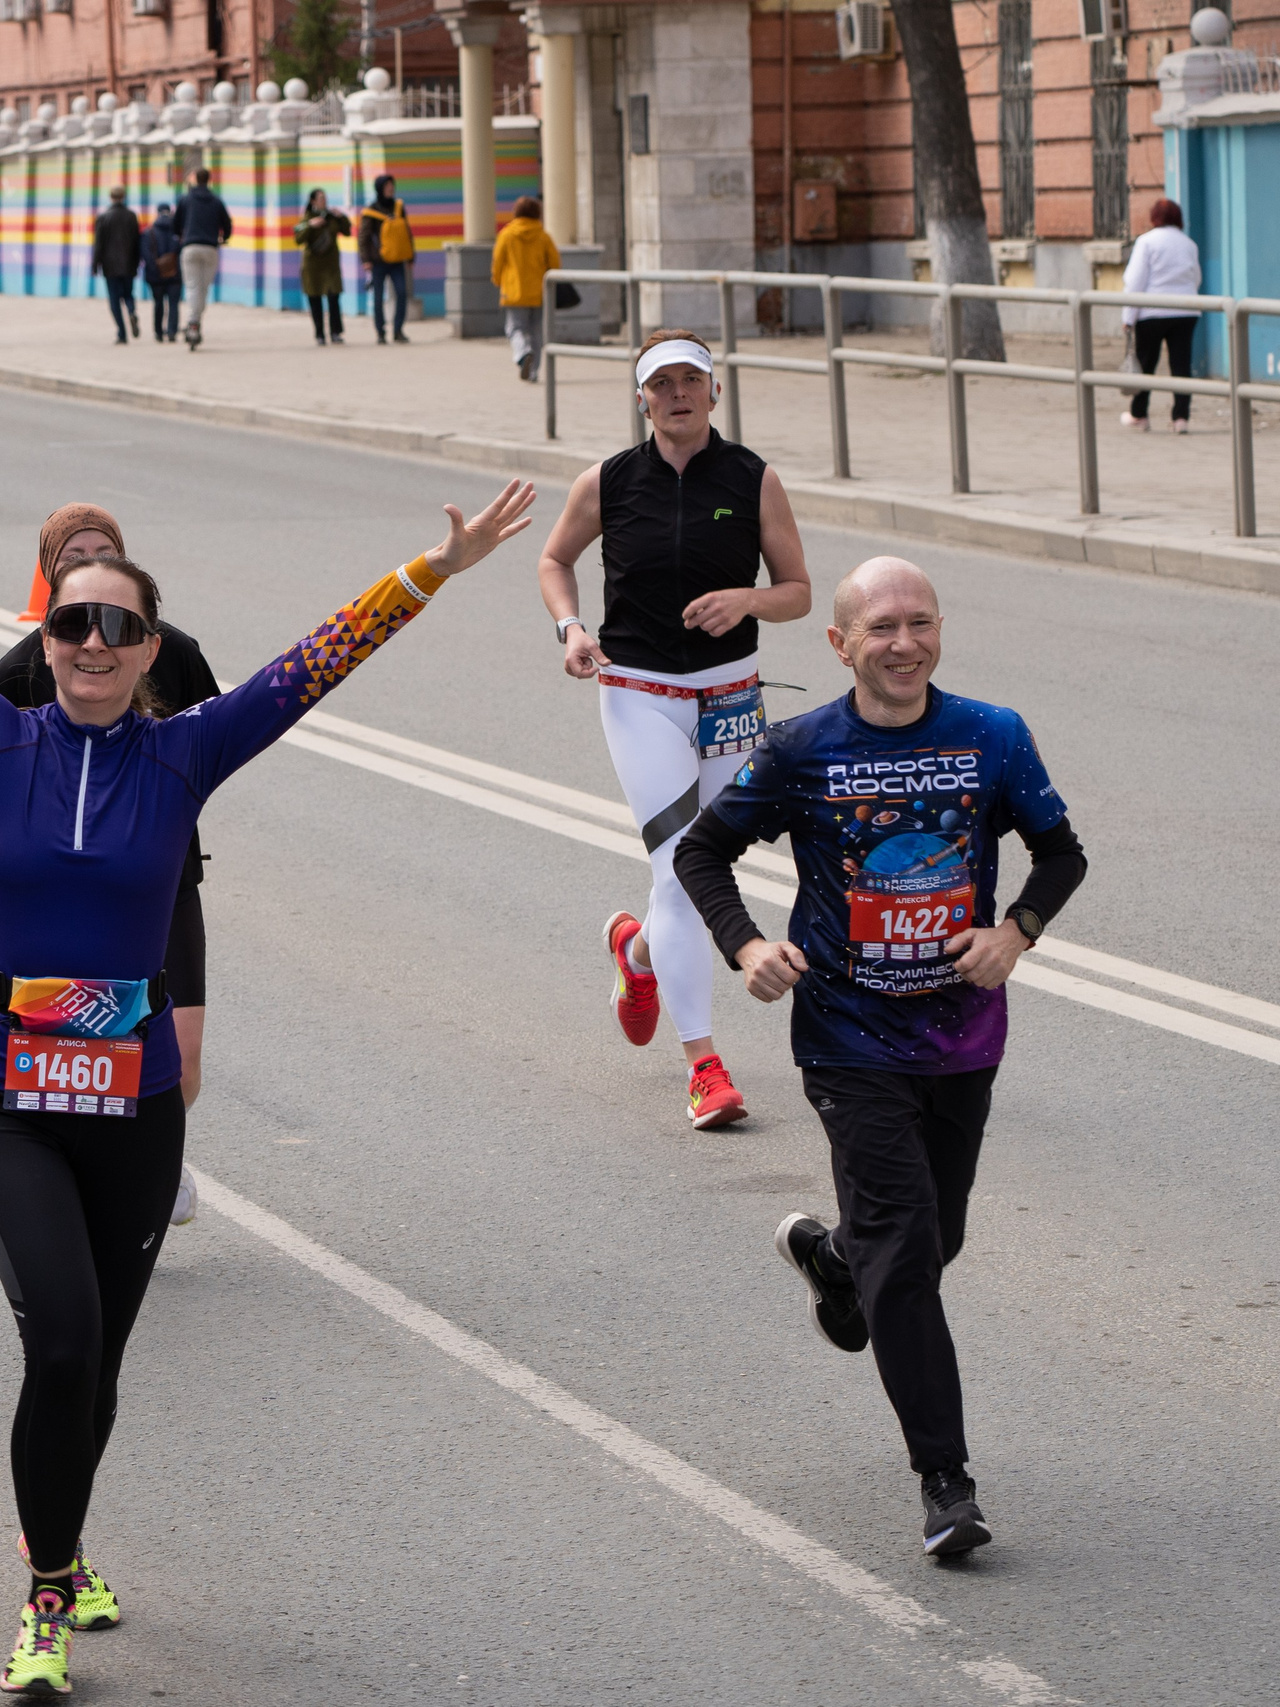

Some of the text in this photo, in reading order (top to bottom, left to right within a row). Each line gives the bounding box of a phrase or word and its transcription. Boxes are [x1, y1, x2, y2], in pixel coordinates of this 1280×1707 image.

[714, 710, 759, 742] 2303
[827, 755, 978, 777] Я ПРОСТО
[829, 771, 980, 796] КОСМОС
[891, 881, 940, 891] КОСМОС
[900, 876, 940, 884] ПРОСТО
[895, 895, 931, 904] АЛЕКСЕЙ
[881, 905, 949, 940] 1422
[954, 908, 964, 919] D
[48, 1000, 87, 1034] SAMARA
[55, 982, 116, 1036] TRAIL
[57, 1039, 87, 1048] АЛИСА
[19, 1057, 30, 1067] D
[34, 1052, 113, 1092] 1460
